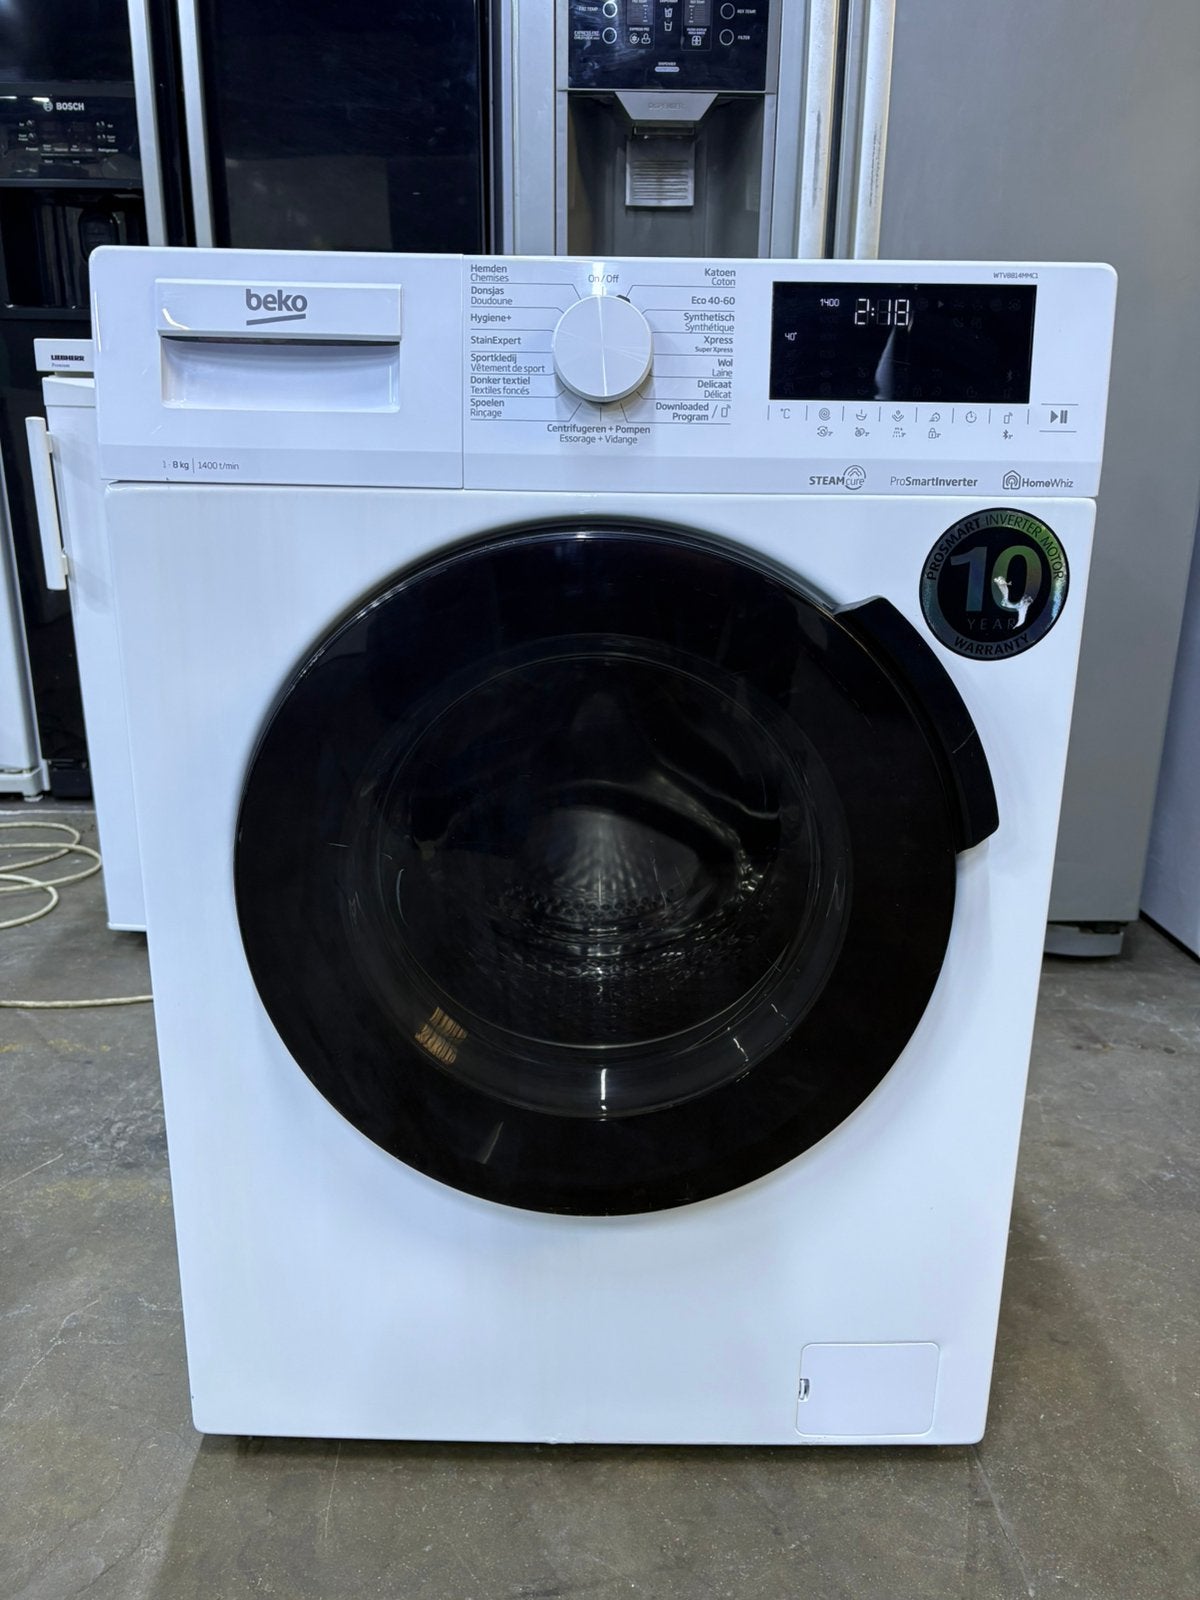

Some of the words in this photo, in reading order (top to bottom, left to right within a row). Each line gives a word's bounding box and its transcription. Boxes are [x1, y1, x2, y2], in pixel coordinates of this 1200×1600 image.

[56, 102, 84, 111] BOSCH
[470, 264, 508, 273] Hemden
[704, 268, 736, 277] Katoen
[470, 273, 509, 282] Chemises
[606, 275, 619, 283] Off
[712, 278, 736, 286] Coton
[471, 286, 504, 296] Donsjas
[246, 288, 308, 312] beko
[471, 296, 513, 305] Doudoune
[692, 297, 706, 305] Eco
[708, 297, 735, 305] 40-60
[820, 298, 840, 307] 1400
[684, 312, 735, 322] Synthetisch
[854, 299, 909, 326] 2:18
[470, 313, 511, 324] Hygiene+
[685, 322, 734, 332] Synthétique
[471, 336, 521, 346] StainExpert
[704, 336, 733, 345] Xpress
[470, 354, 517, 364] Sportkledij
[718, 359, 733, 367] Wol
[471, 364, 510, 372] Vêtement
[512, 364, 522, 372] de
[524, 365, 545, 374] sport
[712, 368, 733, 377] Laine
[470, 376, 500, 384] Donker
[502, 376, 530, 384] textiel
[698, 380, 732, 389] Delicaat
[471, 386, 501, 394] Textiles
[502, 386, 530, 395] foncés
[704, 390, 731, 399] Délicat
[470, 398, 504, 408] Spoelen
[656, 402, 709, 411] Downloaded
[470, 408, 502, 418] Rinçage
[672, 412, 709, 422] Program
[547, 424, 606, 435] Centrifugeren
[615, 425, 650, 435] Pompen
[560, 435, 596, 444] Essorage
[605, 435, 638, 444] Vidange
[180, 462, 189, 470] kg
[890, 476, 978, 487] ProSmartInverter
[1022, 478, 1074, 488] HomeWhiz
[926, 518, 981, 580] PROSMART
[986, 514, 1042, 536] INVERTER
[1040, 536, 1064, 580] MOTOR
[950, 545, 1043, 612] 10
[955, 632, 1029, 656] WARRANTY
